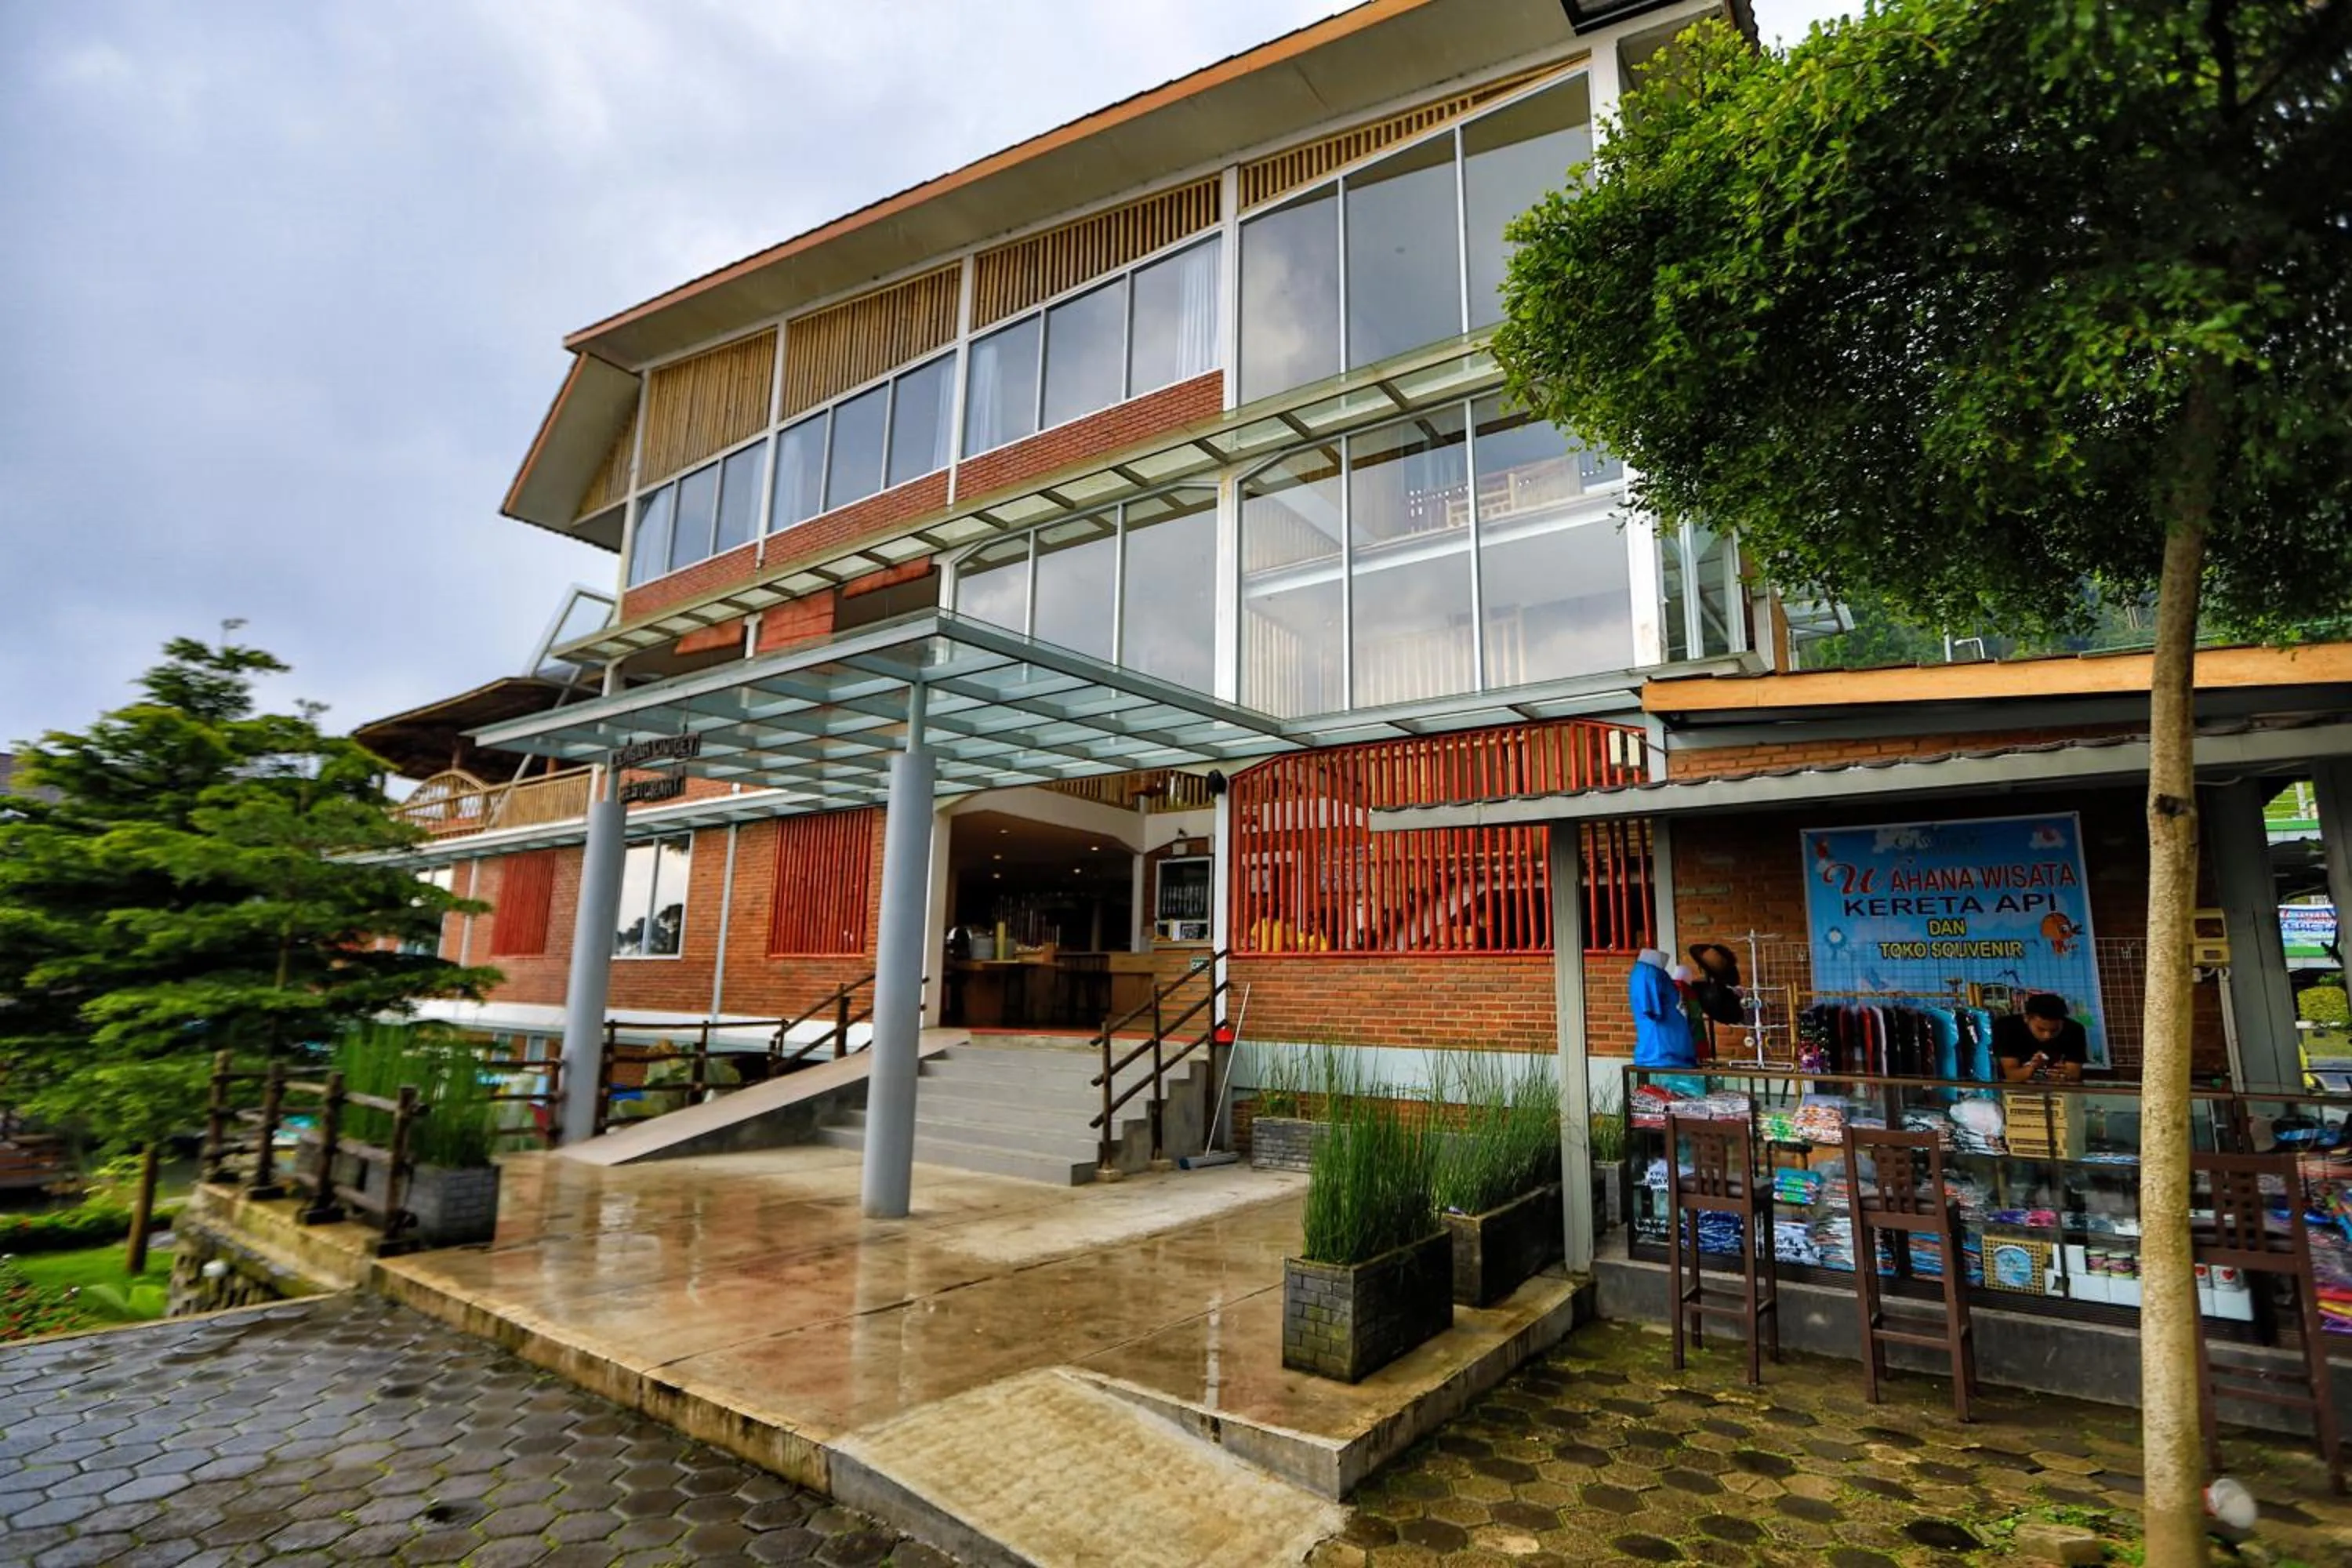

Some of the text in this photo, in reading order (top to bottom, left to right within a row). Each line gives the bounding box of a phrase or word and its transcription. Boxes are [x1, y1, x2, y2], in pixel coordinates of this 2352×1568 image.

[1981, 864, 2077, 890] WISATA
[1844, 894, 2056, 916] KERETA API
[1928, 919, 1967, 937] DAN
[1880, 940, 2024, 960] TOKO SOUVENIR
